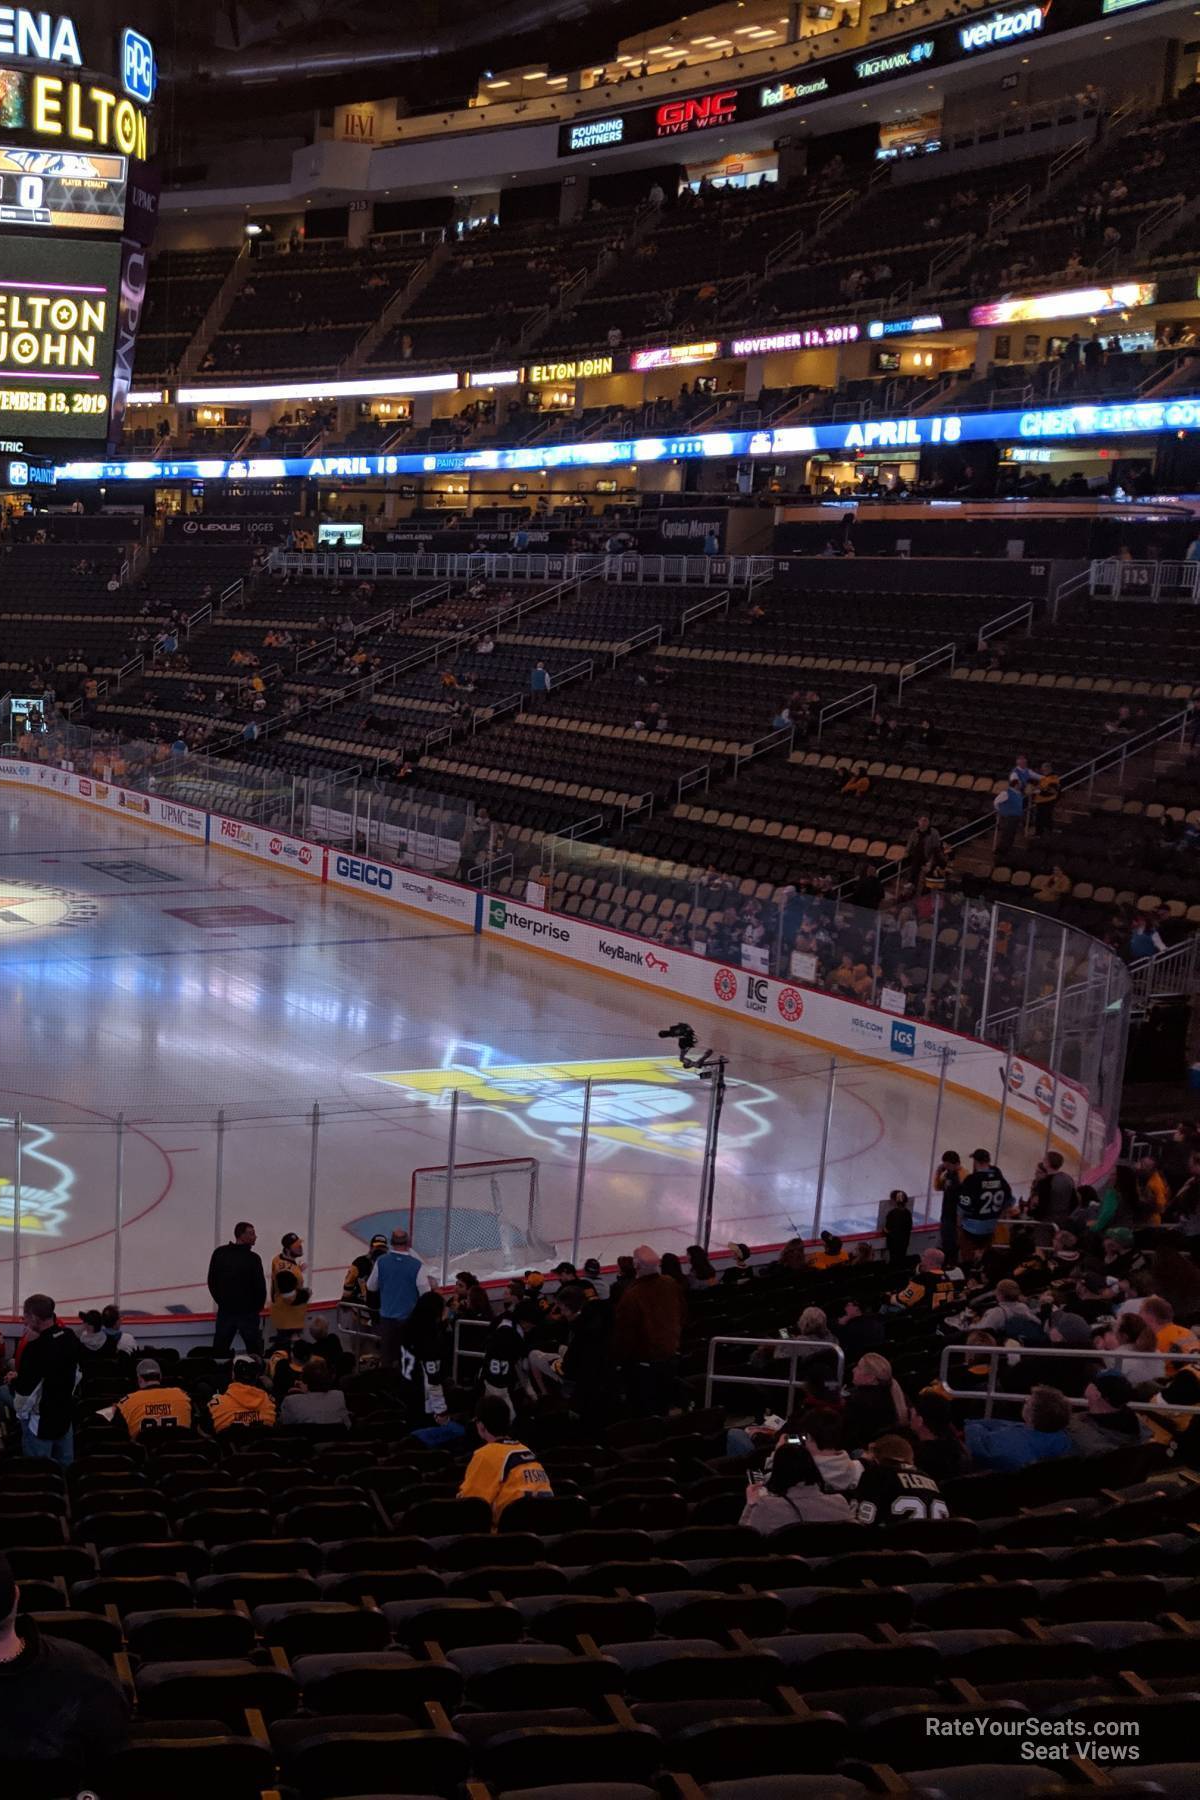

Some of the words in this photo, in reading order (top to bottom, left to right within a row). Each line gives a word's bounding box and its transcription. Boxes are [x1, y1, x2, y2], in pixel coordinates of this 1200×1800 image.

[960, 8, 1043, 50] verizon
[126, 40, 151, 88] PPG
[762, 83, 797, 107] FedEx
[33, 76, 147, 160] ELTON
[657, 90, 737, 125] GNC
[572, 119, 624, 139] FOUNDING
[657, 123, 688, 136] LIVE
[696, 114, 736, 129] WELL
[571, 131, 623, 149] PARTNERS
[19, 177, 43, 208] 0
[61, 179, 81, 187] PLAYER
[84, 180, 108, 189] PENALTY
[735, 334, 800, 354] NOVEMBER
[826, 326, 858, 342] 2019
[531, 362, 576, 382] ELTON
[577, 357, 613, 377] JOHN
[50, 392, 70, 415] 13,
[72, 393, 107, 414] 2019
[845, 418, 921, 447] APRIL
[930, 416, 962, 442] 18
[309, 457, 371, 476] APRIL
[377, 456, 398, 474] 18
[200, 523, 241, 532] LEXUS
[248, 523, 274, 532] LOGES
[662, 519, 690, 539] Captain
[690, 520, 721, 537] Morgan
[161, 803, 187, 827] UPMC
[221, 820, 241, 838] FAST
[336, 855, 393, 890] GEICO
[402, 881, 427, 895] VECTOR
[434, 892, 466, 908] SECURITY
[495, 906, 570, 942] enterprise
[599, 940, 643, 967] KeyBank
[747, 1001, 767, 1013] LIGHT
[851, 1018, 884, 1034] IGS.COM
[894, 1029, 914, 1047] IGS
[978, 1190, 1005, 1215] 29
[488, 1359, 510, 1375] 87
[145, 1403, 172, 1416] CROSBY
